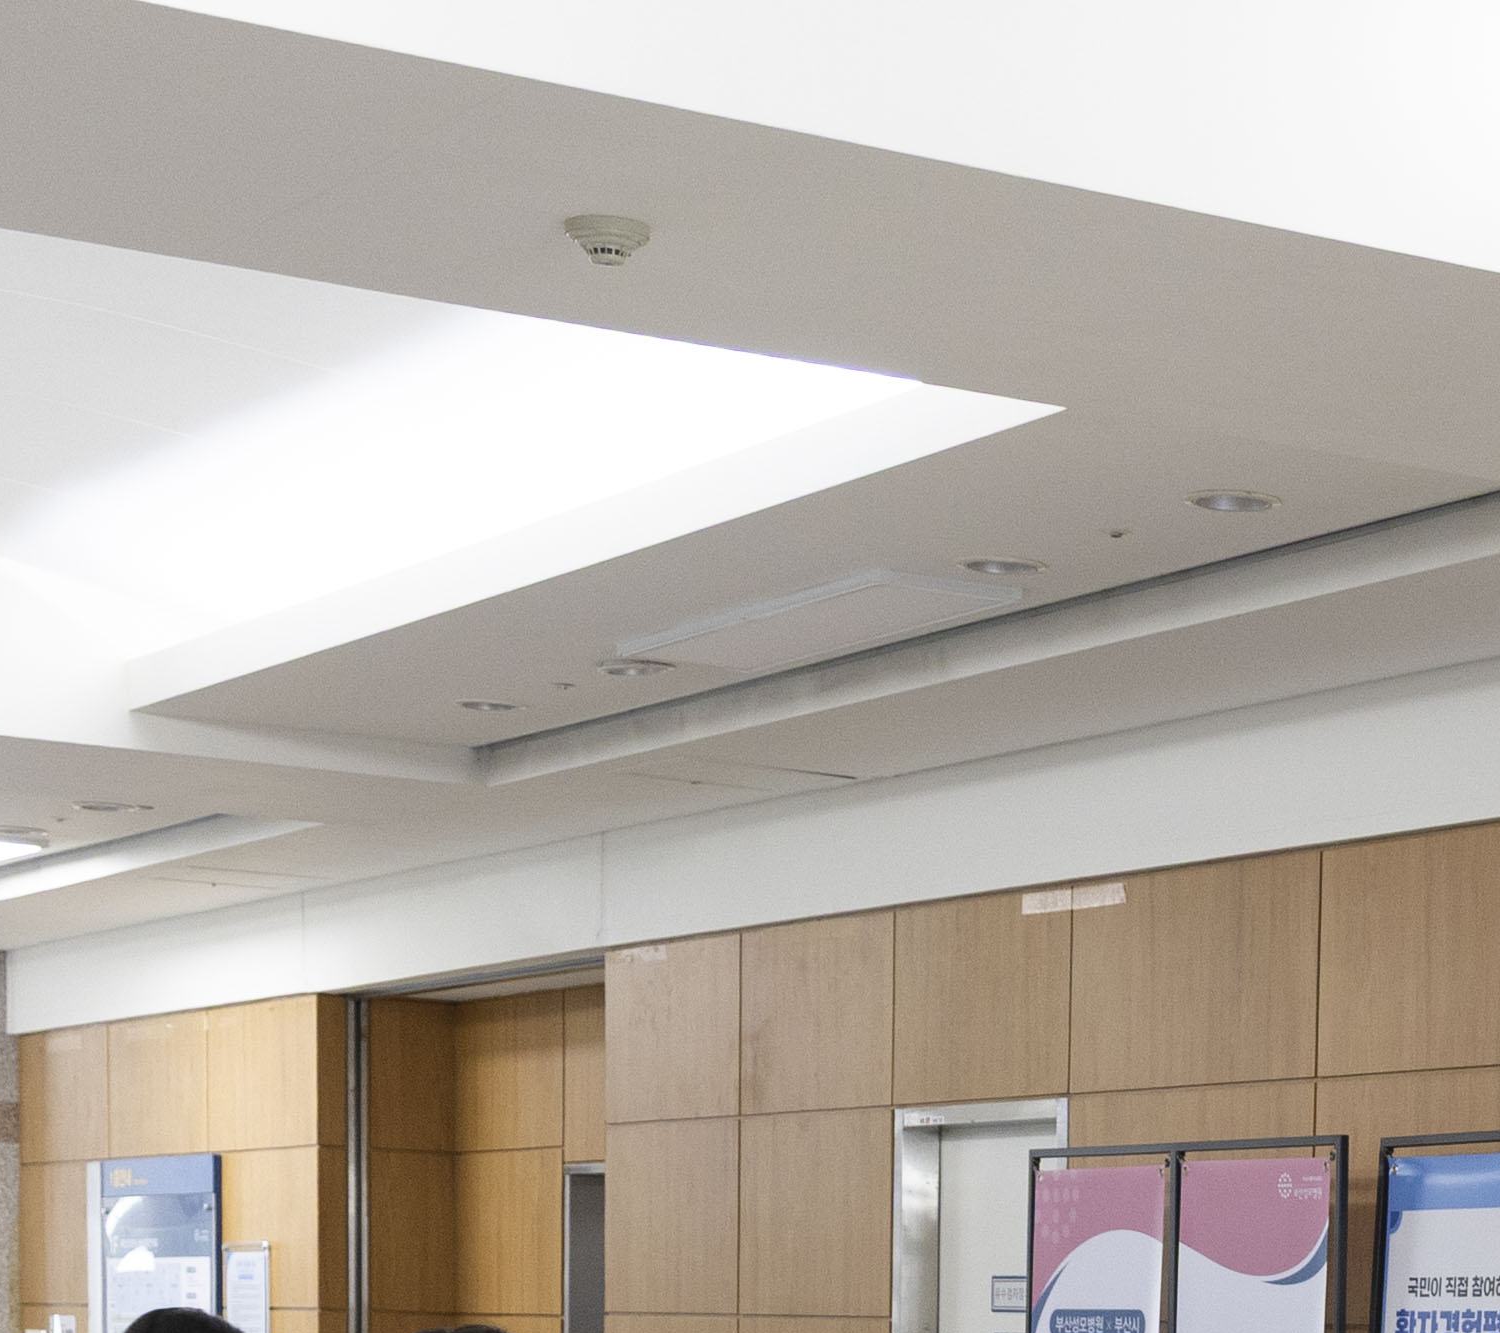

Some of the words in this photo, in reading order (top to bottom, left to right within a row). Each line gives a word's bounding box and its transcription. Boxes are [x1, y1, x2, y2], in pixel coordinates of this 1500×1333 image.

[1408, 1277, 1442, 1297] 국민이
[1445, 1276, 1468, 1297] 직접
[1055, 1316, 1104, 1333] 부산성모병원
